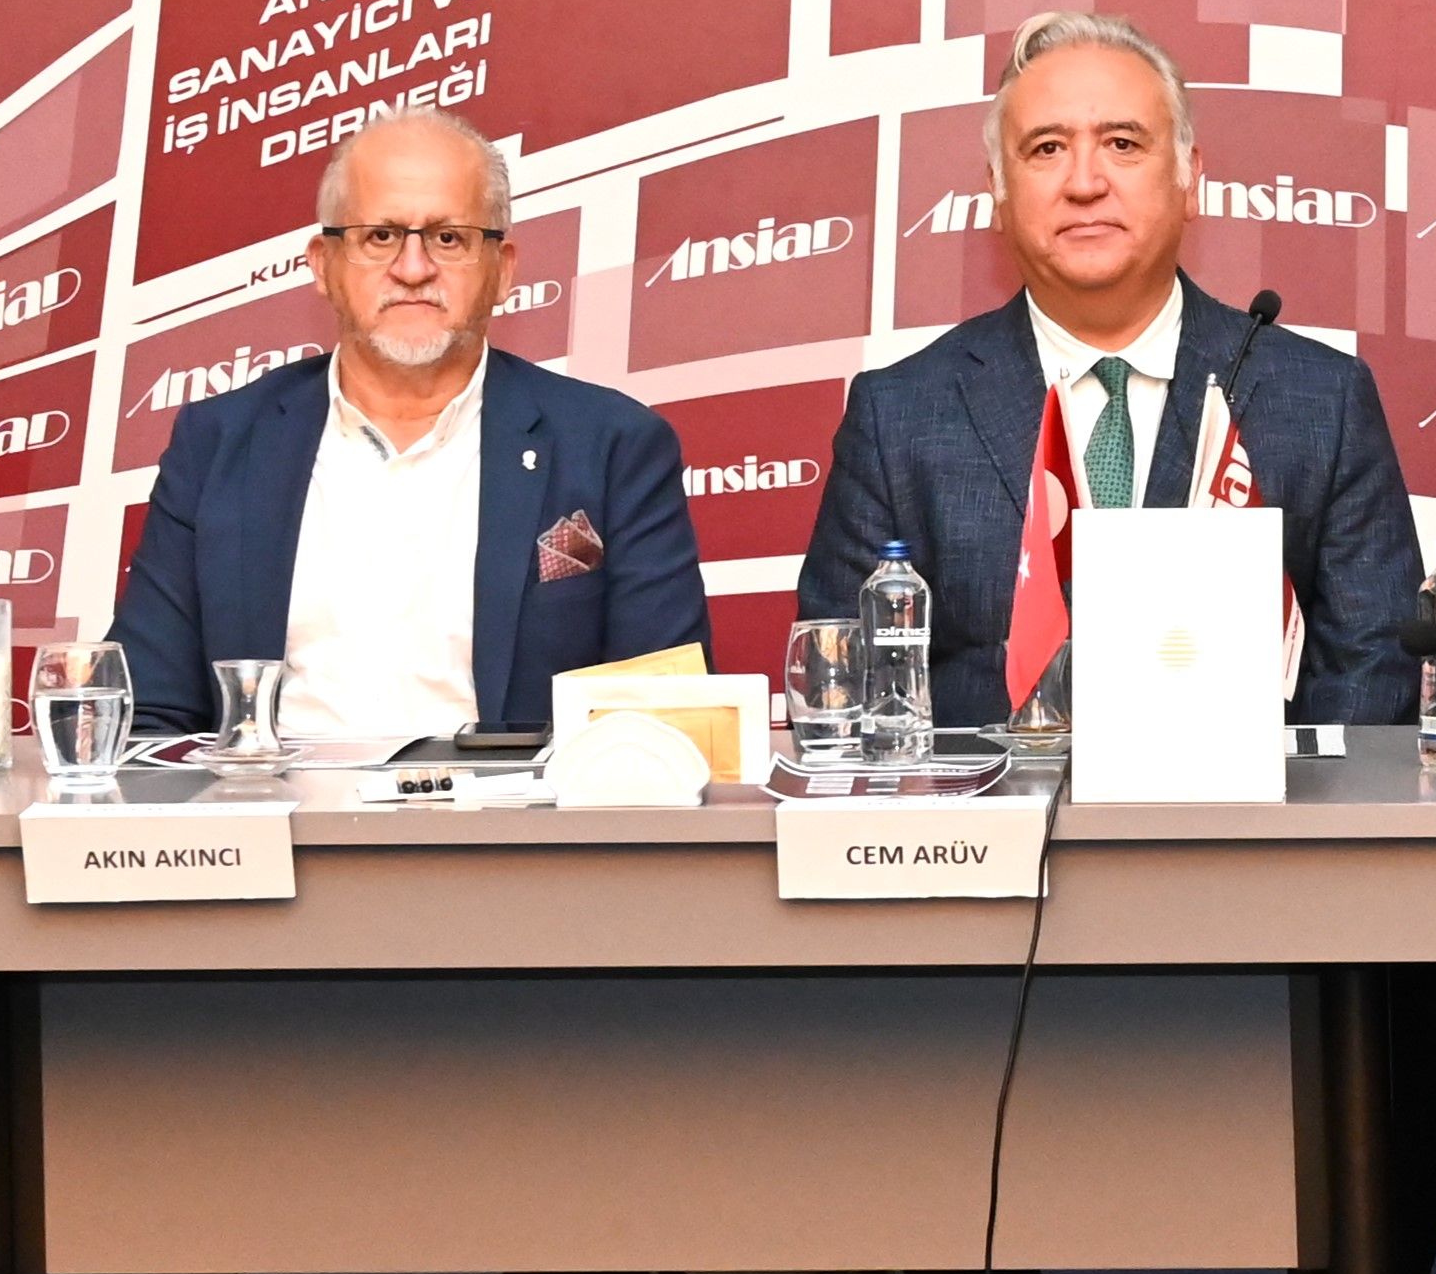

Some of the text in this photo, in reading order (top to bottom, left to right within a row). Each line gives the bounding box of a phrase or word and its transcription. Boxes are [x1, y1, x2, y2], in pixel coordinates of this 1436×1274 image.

[163, 12, 491, 155] İŞ İNSANLARI
[84, 848, 241, 869] AKIN AKINCI
[846, 840, 988, 865] CEM ARÜV
